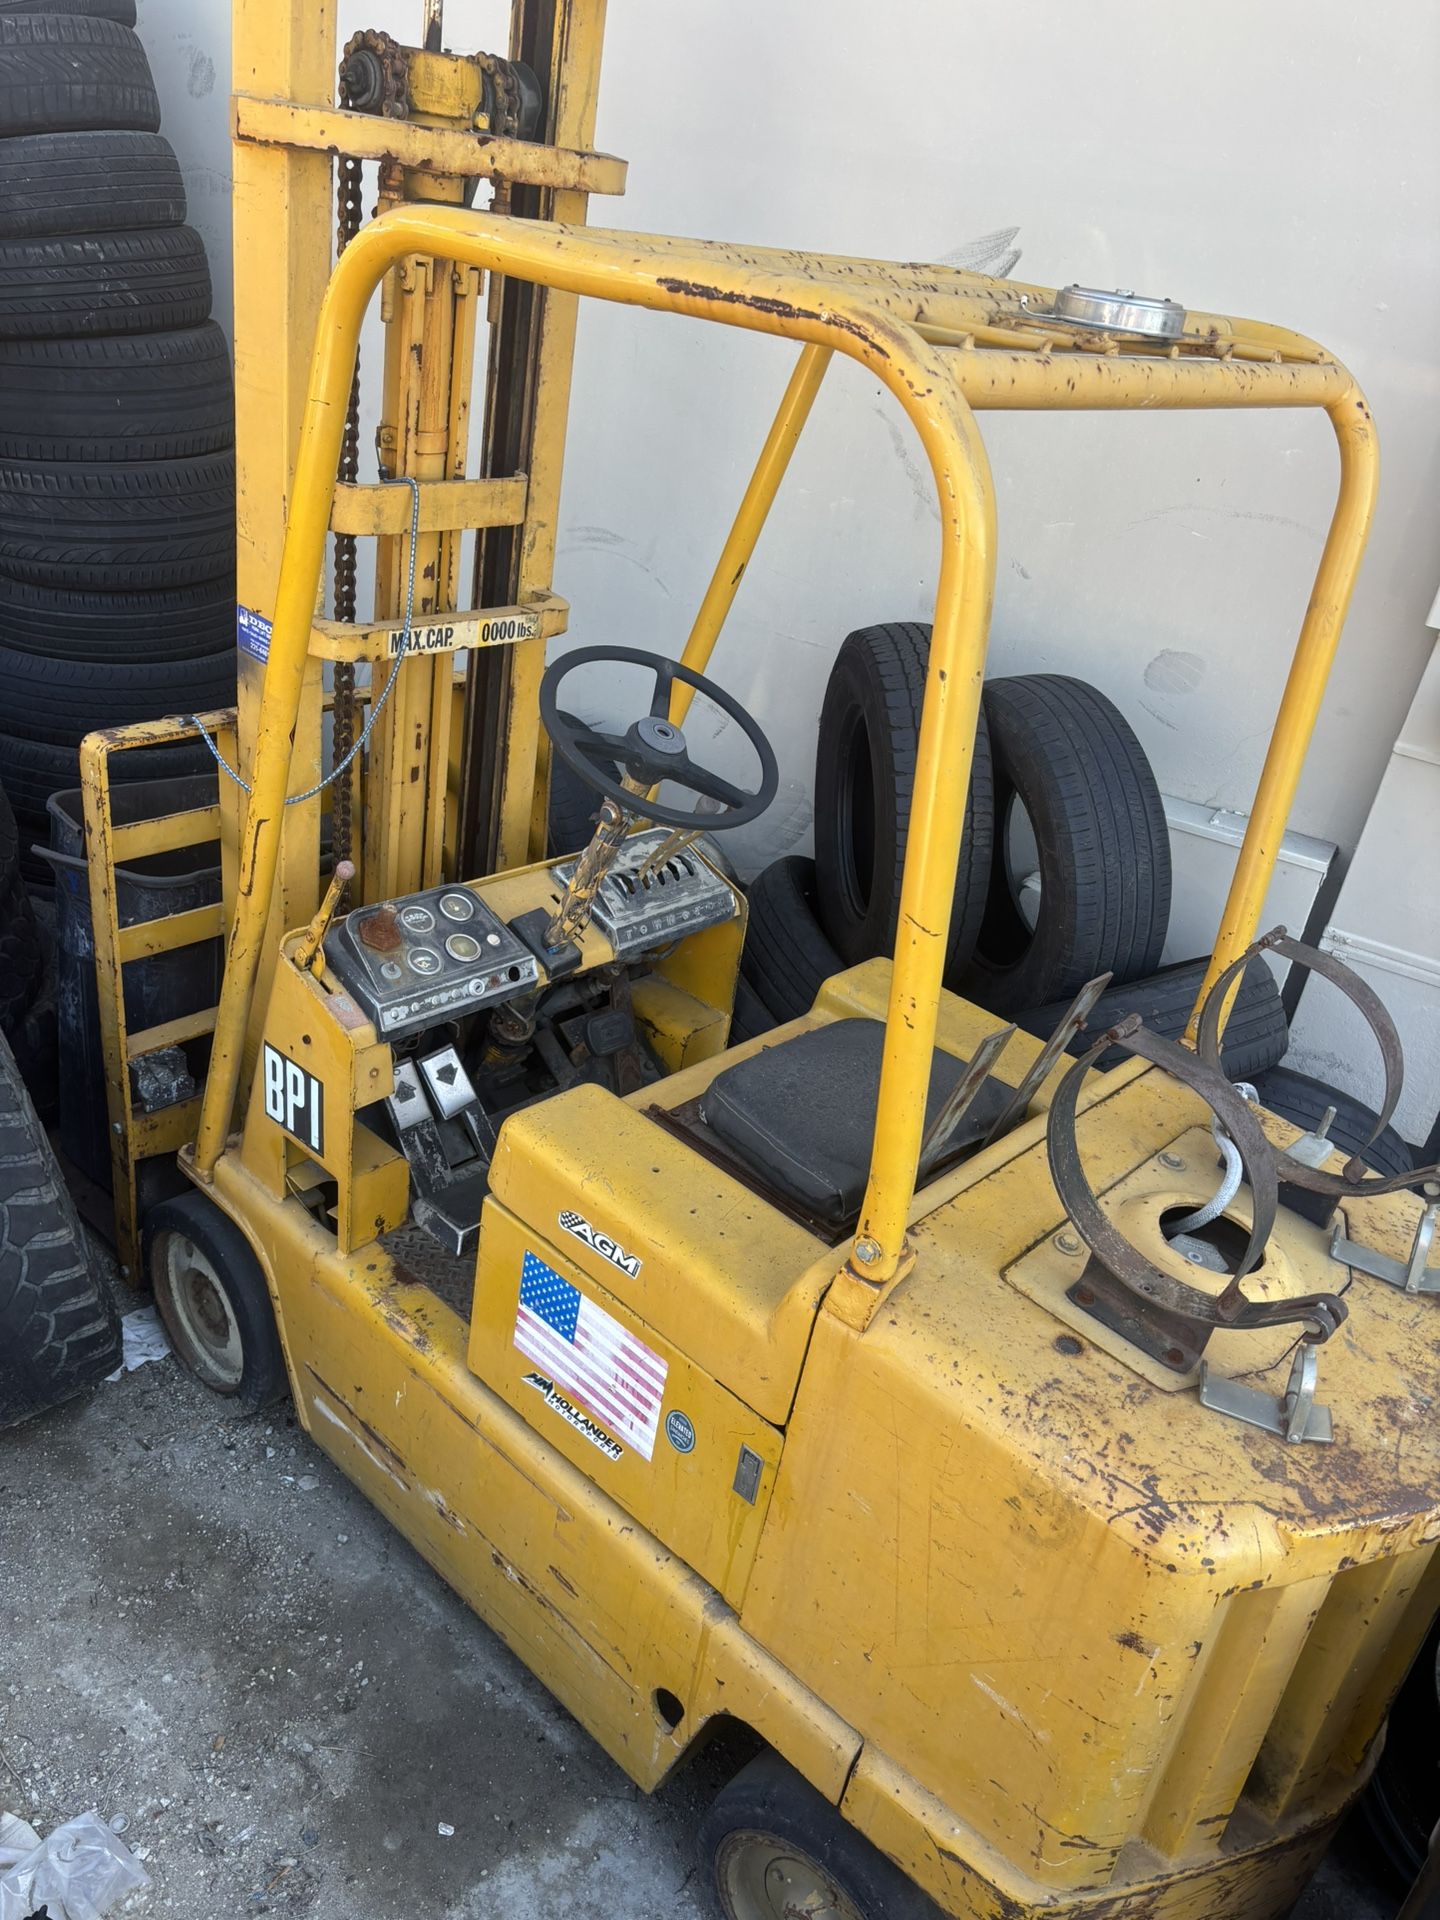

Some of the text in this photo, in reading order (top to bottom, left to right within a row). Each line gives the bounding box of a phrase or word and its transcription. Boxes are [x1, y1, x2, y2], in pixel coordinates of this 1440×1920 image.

[481, 620, 516, 642] 0000
[516, 622, 535, 639] lbs.
[264, 1044, 319, 1150] BPI
[569, 1222, 638, 1274] AGM
[547, 1398, 618, 1460] MOTORSPORTS
[550, 1392, 623, 1455] HOLLANDER
[670, 1416, 692, 1439] ELEVATED
